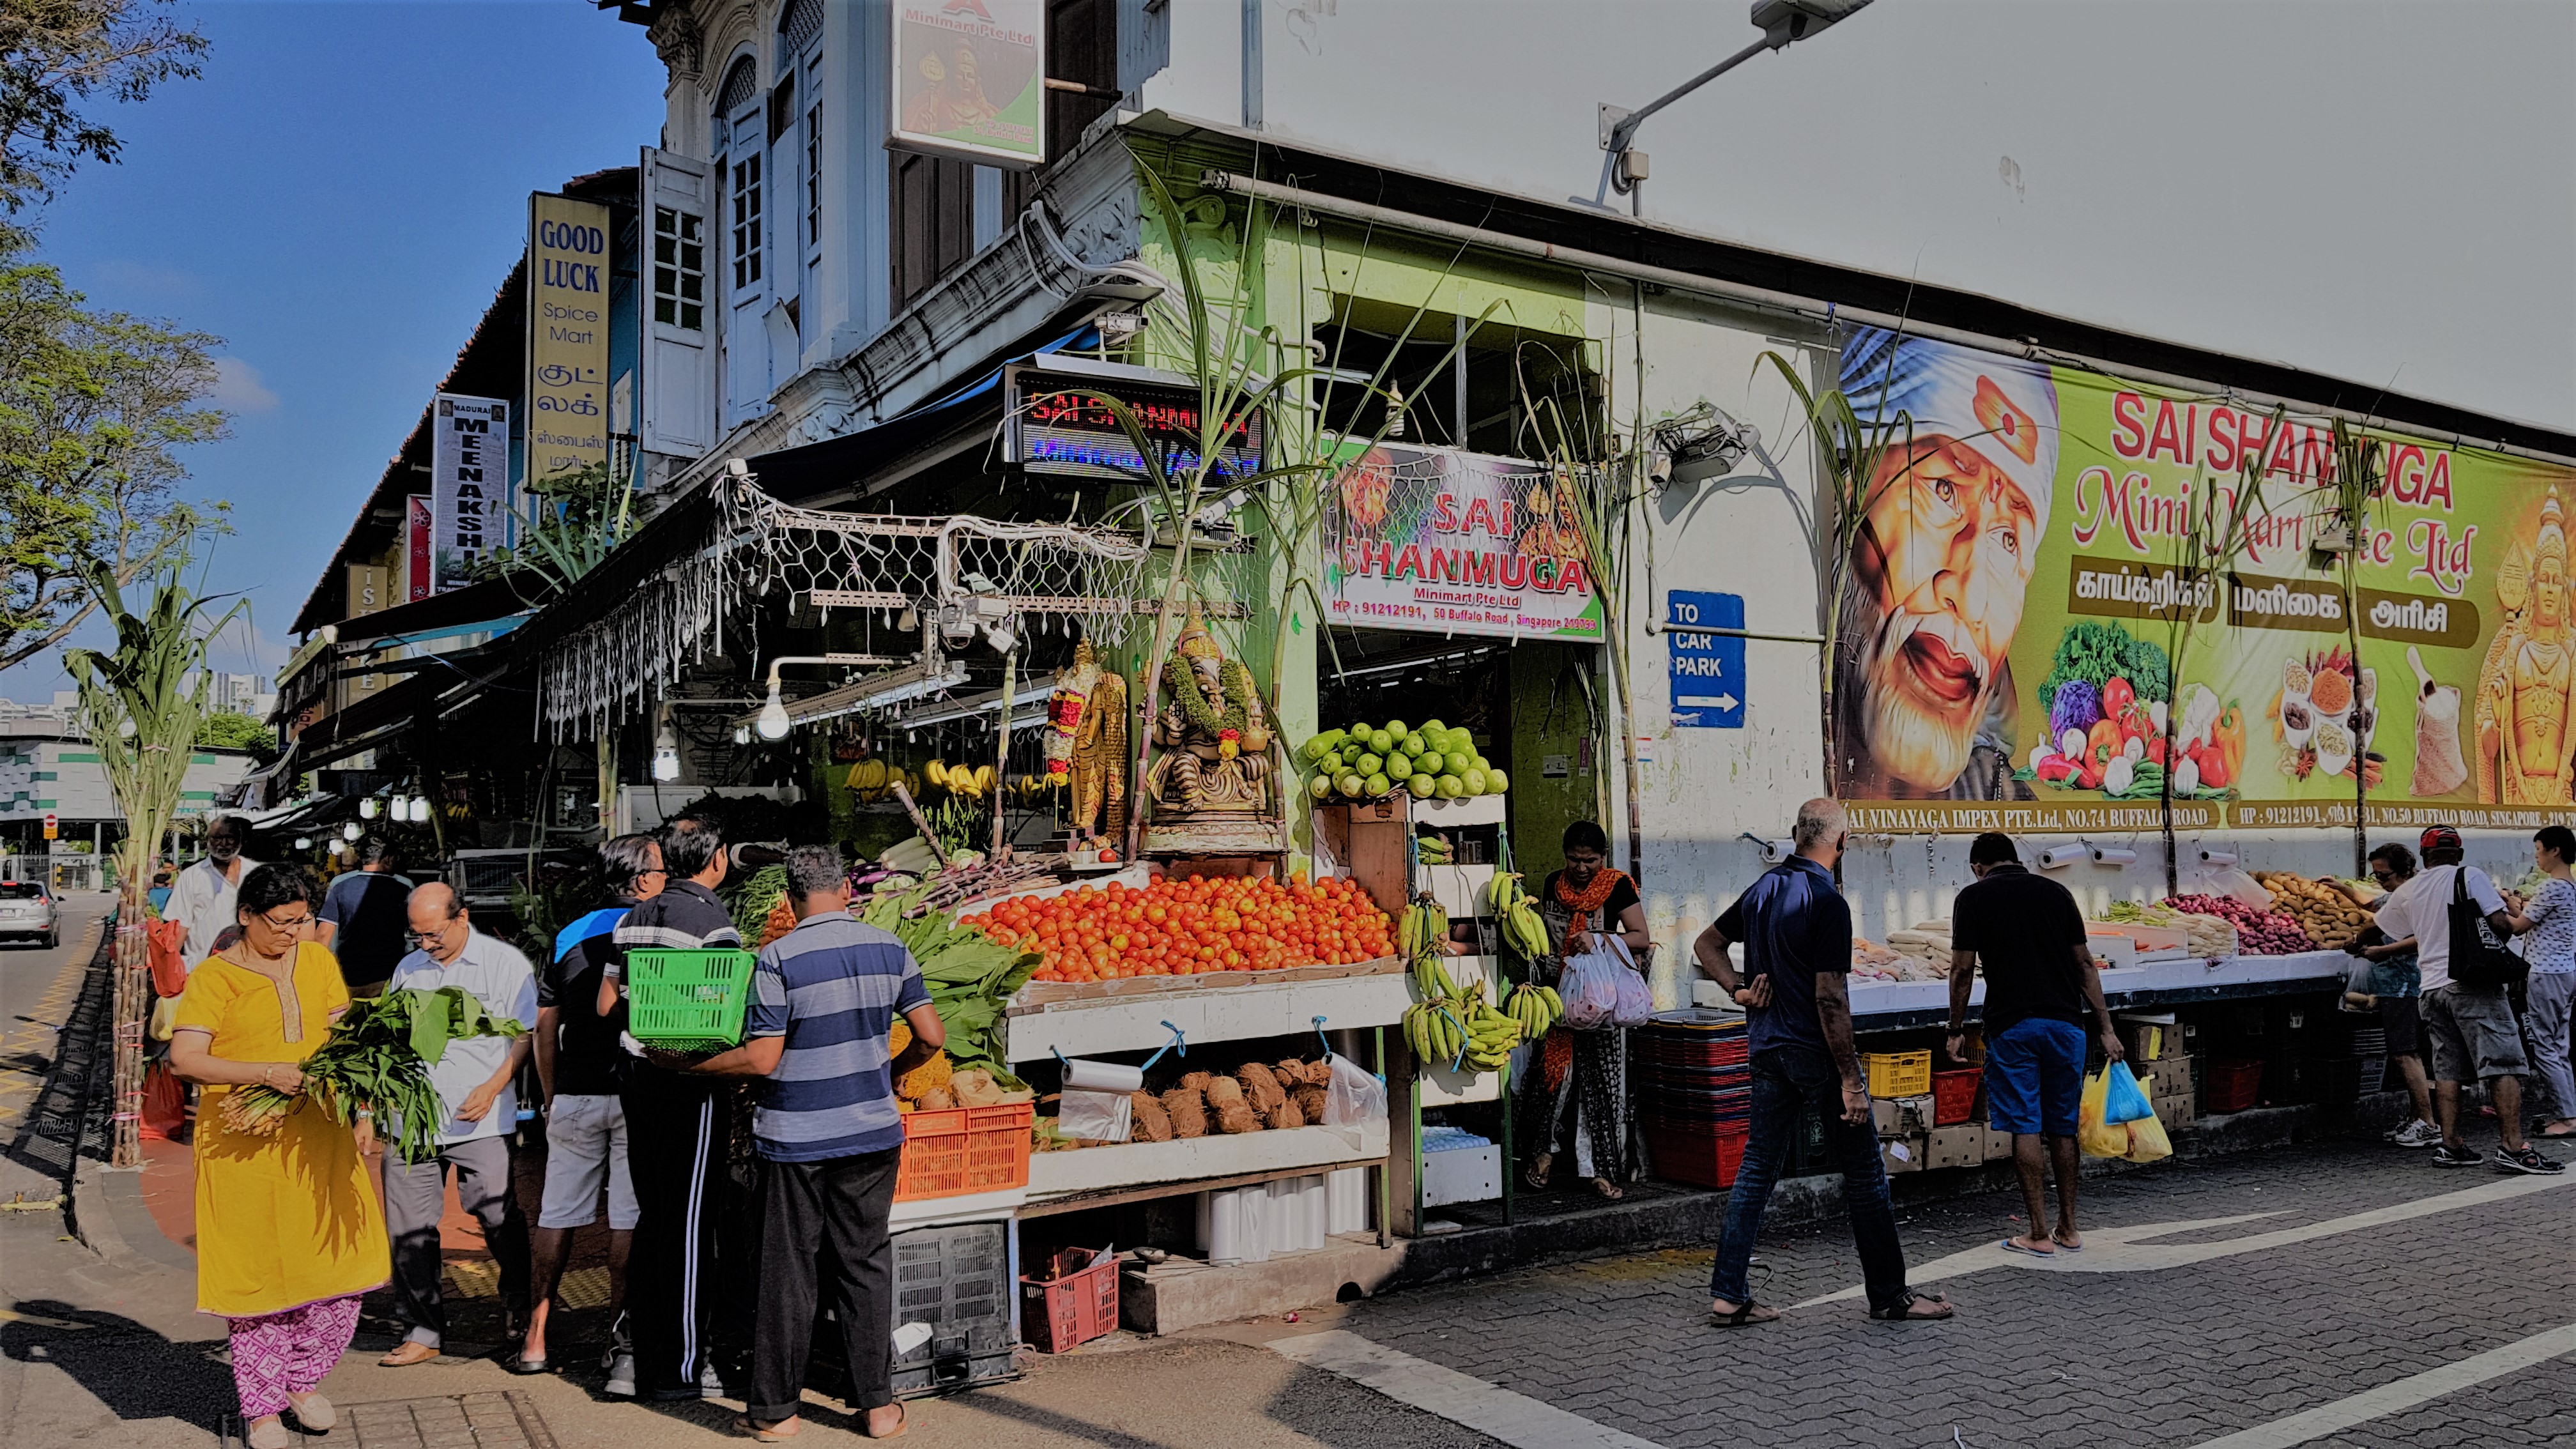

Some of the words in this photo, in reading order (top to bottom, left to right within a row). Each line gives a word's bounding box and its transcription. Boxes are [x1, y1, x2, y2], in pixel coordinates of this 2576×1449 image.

[905, 8, 975, 33] Minimart
[980, 24, 1004, 38] Pte
[1009, 29, 1032, 44] Ltd
[540, 220, 603, 254] GOOD
[544, 259, 599, 293] LUCK
[544, 302, 598, 322] Spice
[550, 326, 593, 344] Mart
[538, 364, 603, 387] குட்
[454, 404, 491, 414] MADURAI
[537, 393, 599, 416] லக்
[2113, 392, 2196, 464] SAI
[2207, 407, 2451, 509] SHANUGA
[454, 417, 488, 562] MEENAKSHI
[1435, 493, 1512, 536] SAI
[2074, 469, 2190, 550] Mini
[2408, 521, 2476, 594] Ltd
[1414, 587, 1472, 602] Minimart
[1476, 593, 1496, 604] Pte
[1499, 595, 1519, 606] Ltd
[1333, 600, 1350, 613] HP
[1449, 608, 1482, 622] Buffalo
[1485, 611, 1508, 623] Road
[1517, 614, 1561, 629] Singapore
[1675, 603, 1698, 623] TO
[2370, 599, 2449, 632] அரிசி
[1675, 633, 1712, 650] CAR
[1676, 657, 1722, 677] PARK
[1848, 809, 1865, 829] AI
[1869, 808, 1949, 829] VINAYAGA
[1952, 809, 2000, 829] IMPEX
[2066, 808, 2106, 828] NO.74
[2110, 808, 2168, 827] BUFFALO
[2174, 808, 2208, 826] ROAD
[2240, 807, 2257, 824] HP
[2266, 806, 2327, 825] 91212191,
[2382, 807, 2411, 824] NO.50
[2413, 808, 2458, 825] BUFFALO
[2460, 809, 2489, 829] ROAD,
[2491, 810, 2542, 827] SINGAPORE
